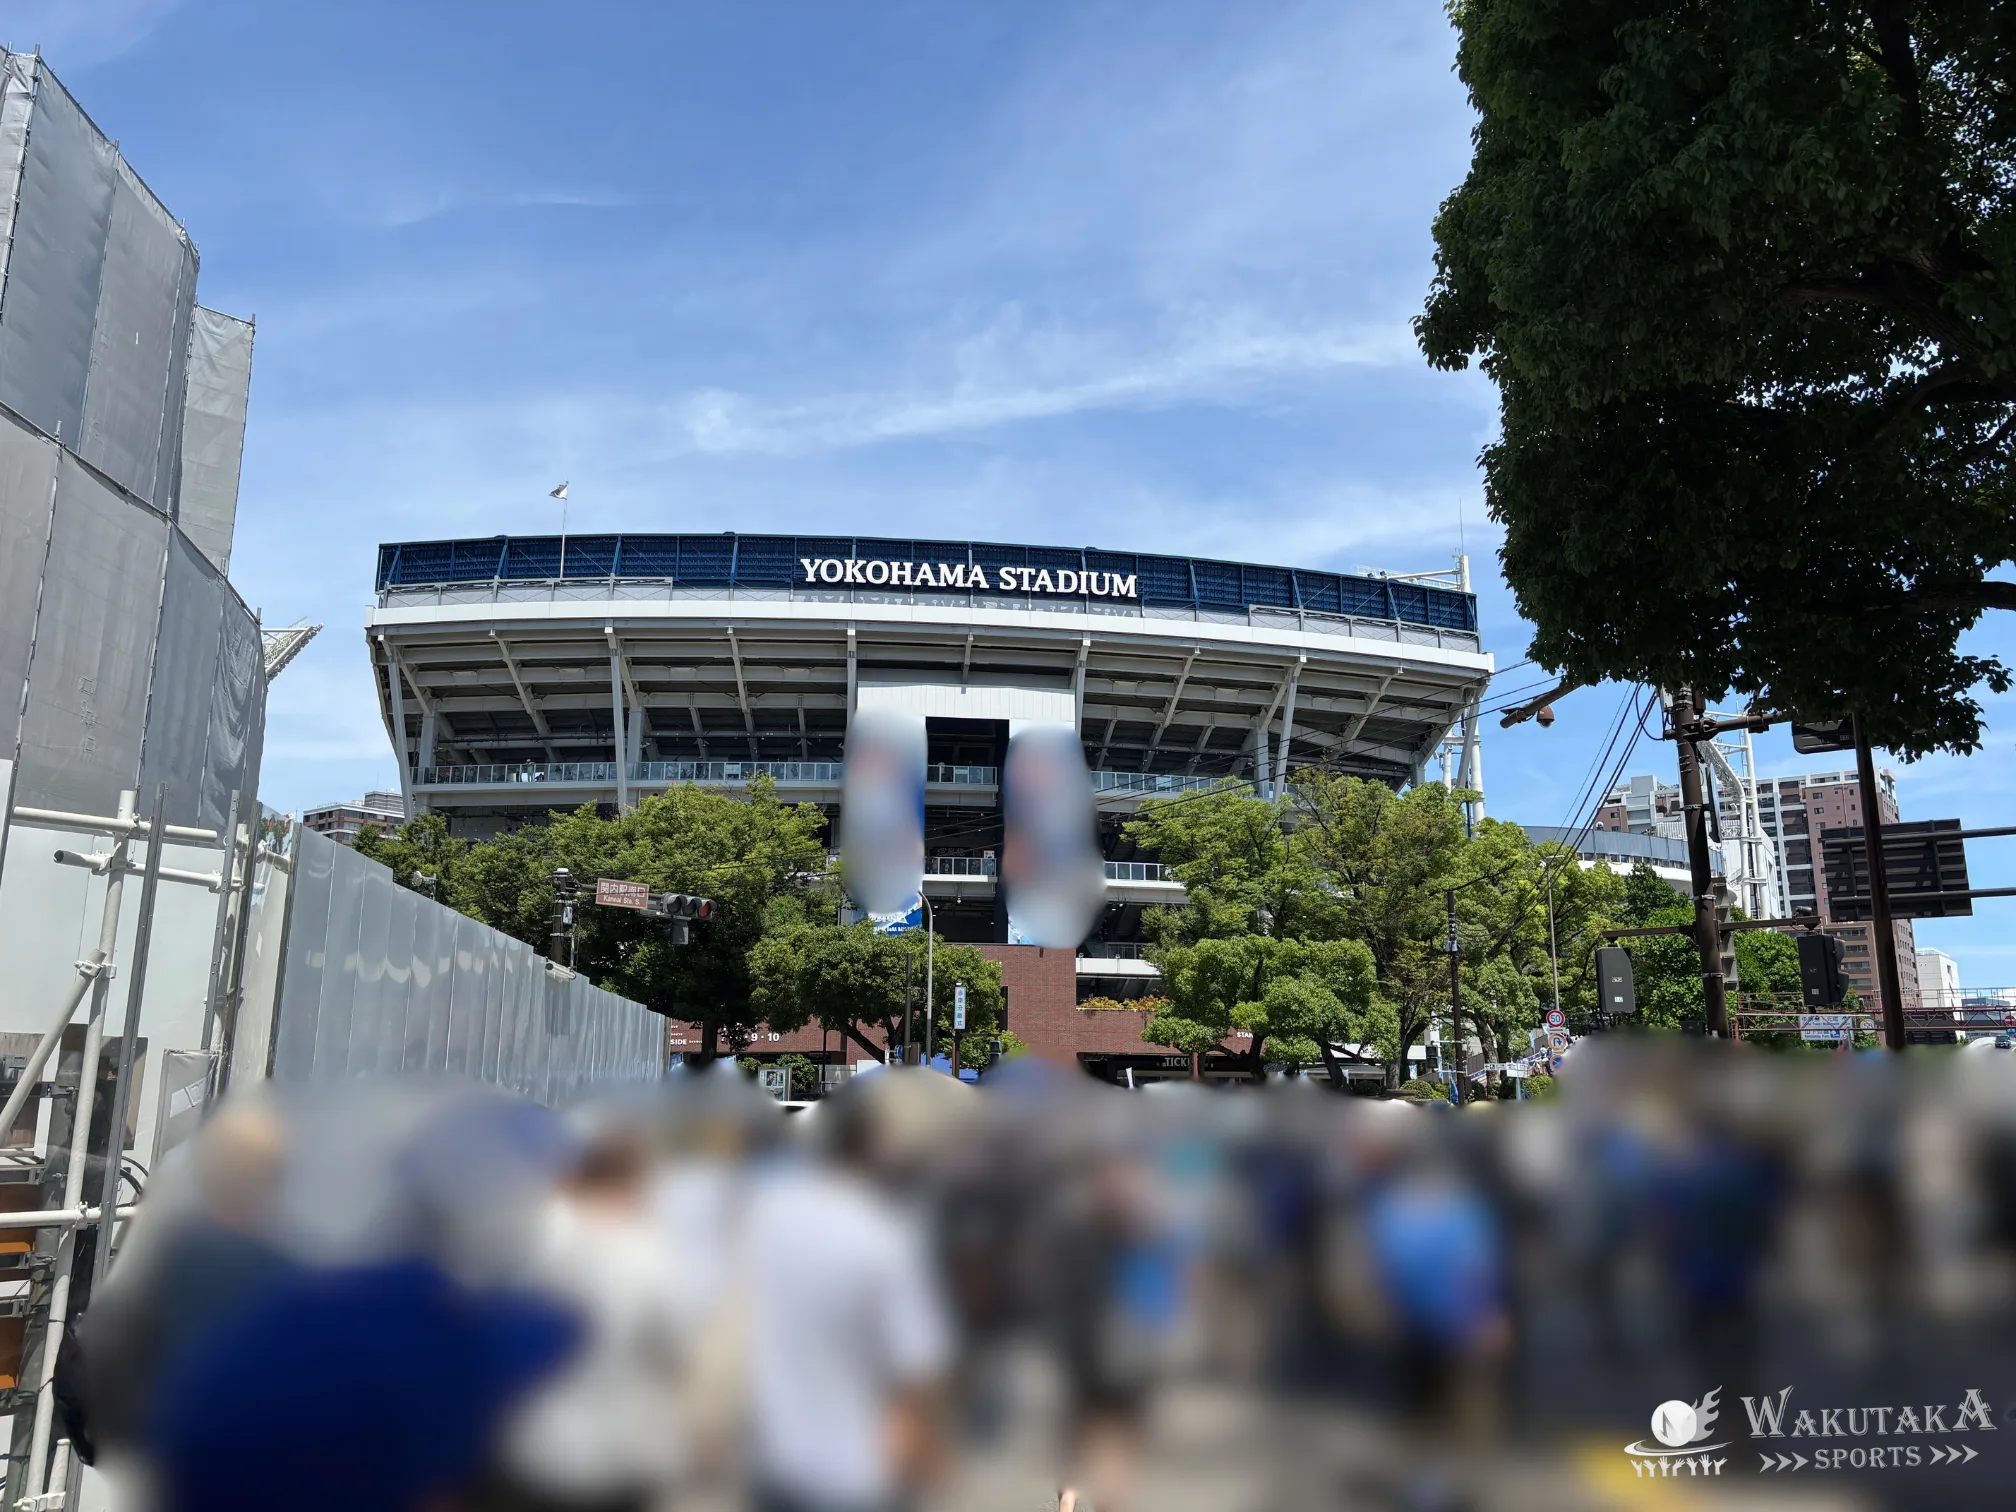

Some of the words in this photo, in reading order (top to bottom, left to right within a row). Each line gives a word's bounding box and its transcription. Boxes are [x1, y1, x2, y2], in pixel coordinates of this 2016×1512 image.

[800, 558, 990, 589] YOKOHAMA
[999, 566, 1137, 598] STADIUM
[600, 882, 646, 898] 関内駅南口
[603, 895, 622, 903] Kannai
[1550, 1014, 1561, 1023] 50
[670, 1038, 687, 1046] SIDE
[1165, 1057, 1190, 1067] TICK
